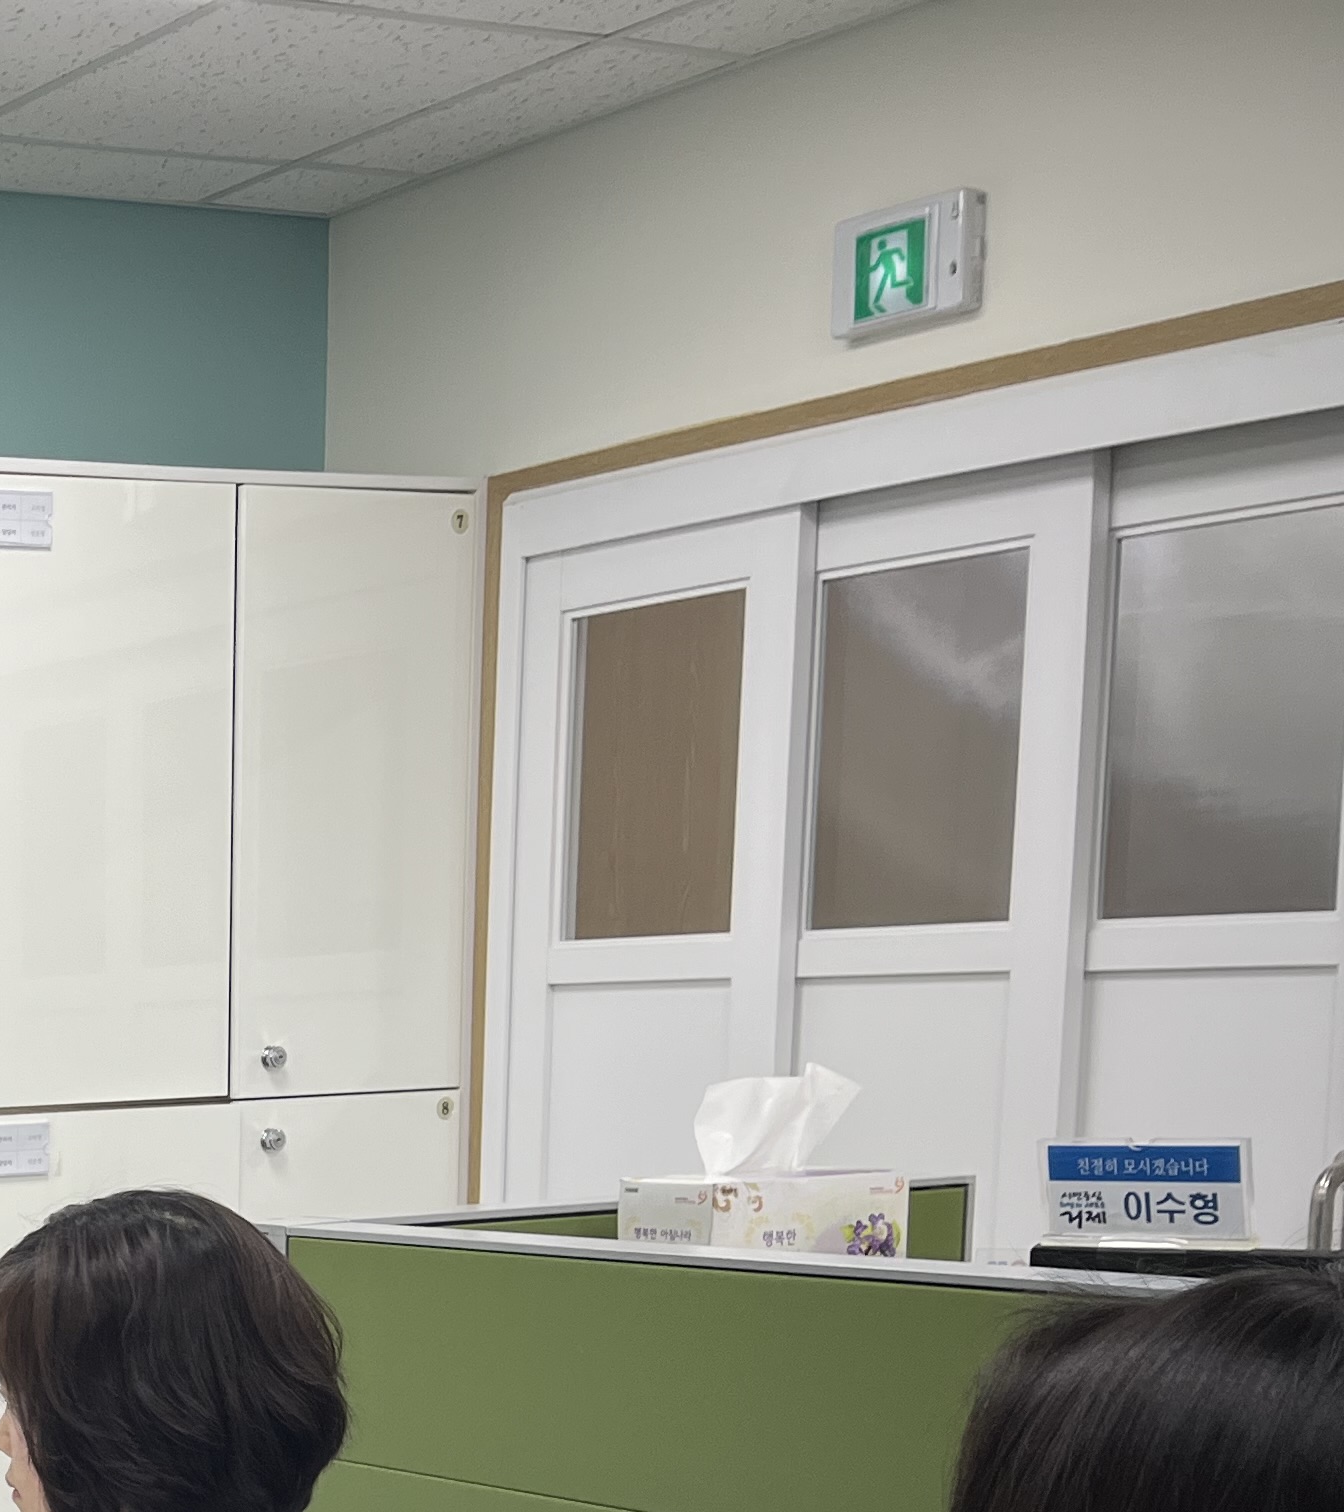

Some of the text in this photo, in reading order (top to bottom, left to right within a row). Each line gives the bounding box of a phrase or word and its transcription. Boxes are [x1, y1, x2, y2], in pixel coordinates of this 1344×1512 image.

[455, 514, 464, 529] 7
[441, 1101, 450, 1116] 8
[1076, 1156, 1211, 1177] 친절히 모시겠습니다
[1123, 1191, 1220, 1226] 이수형
[1059, 1209, 1107, 1229] 거제
[762, 1229, 798, 1248] 행복한
